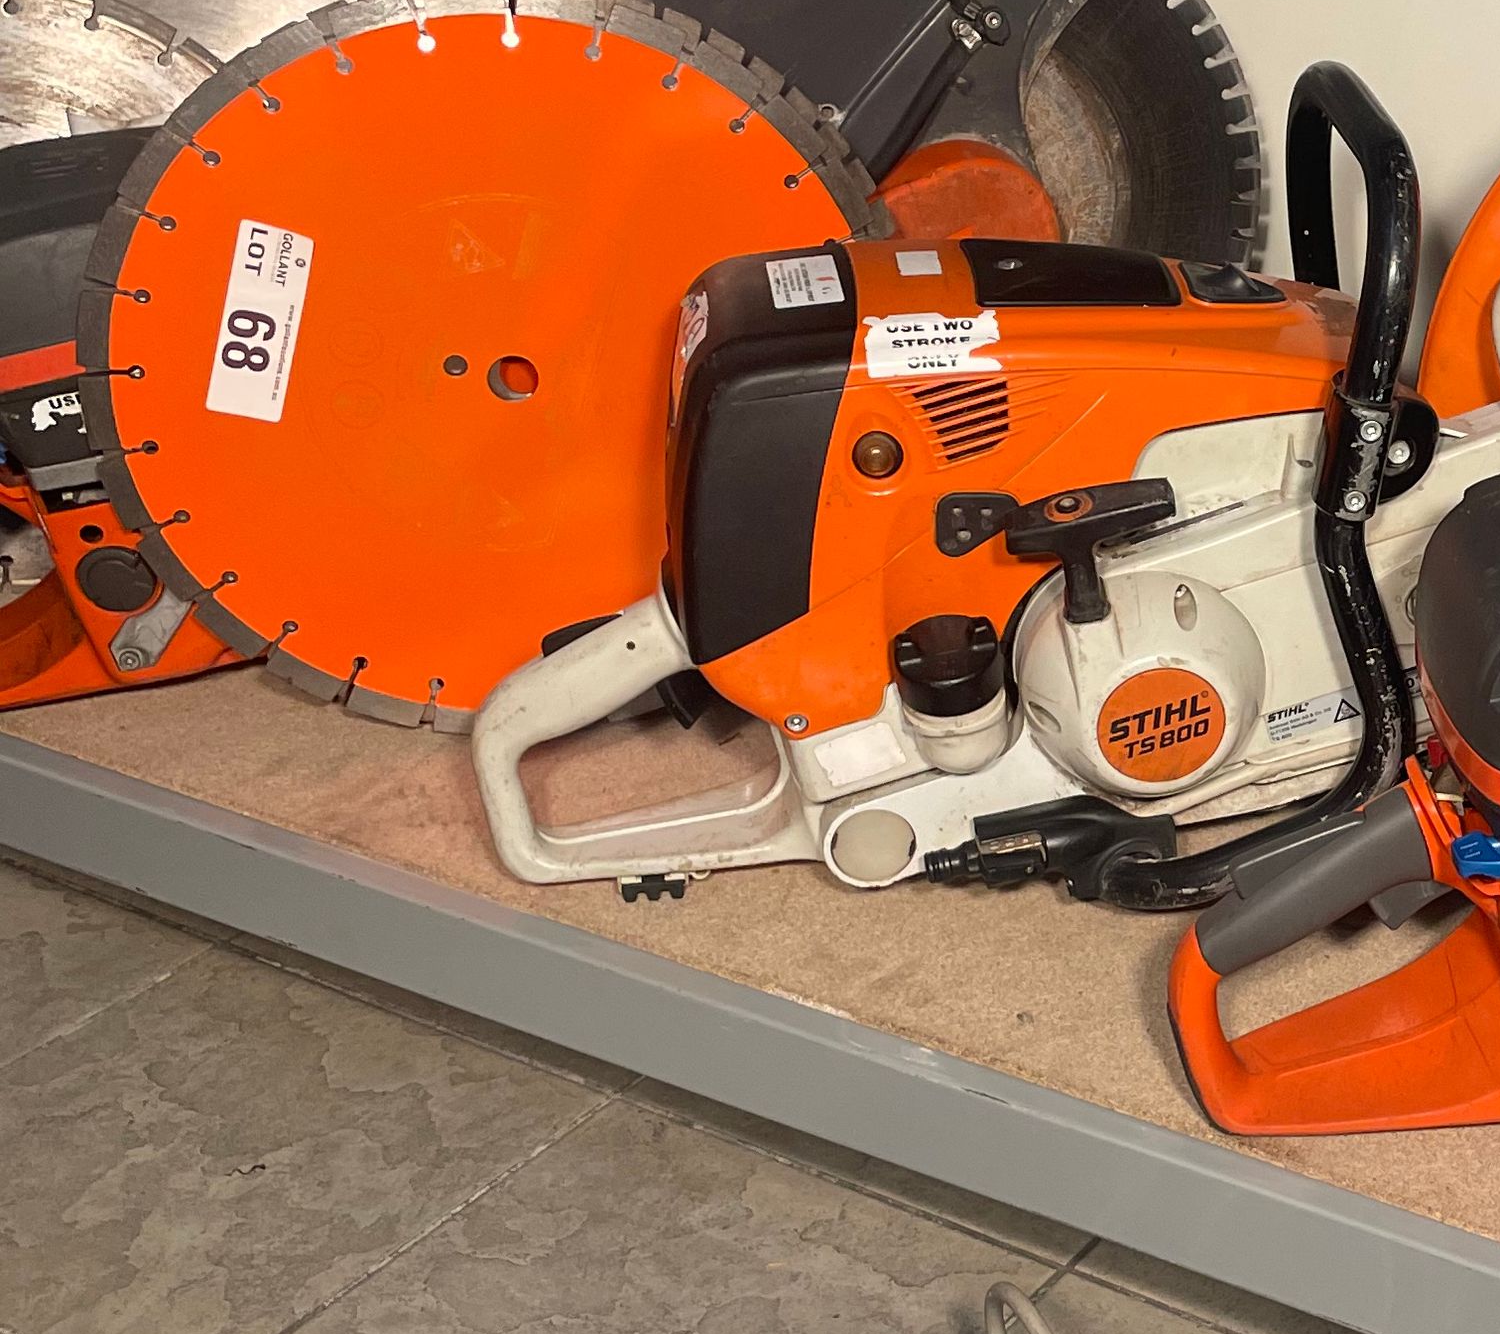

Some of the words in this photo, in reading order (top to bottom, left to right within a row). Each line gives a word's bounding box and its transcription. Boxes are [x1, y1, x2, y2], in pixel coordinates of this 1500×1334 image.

[245, 227, 268, 276] LOT
[275, 233, 293, 287] GOLLANT
[222, 309, 277, 372] 68
[1108, 694, 1211, 744] STIHL
[1267, 703, 1307, 723] STIHL
